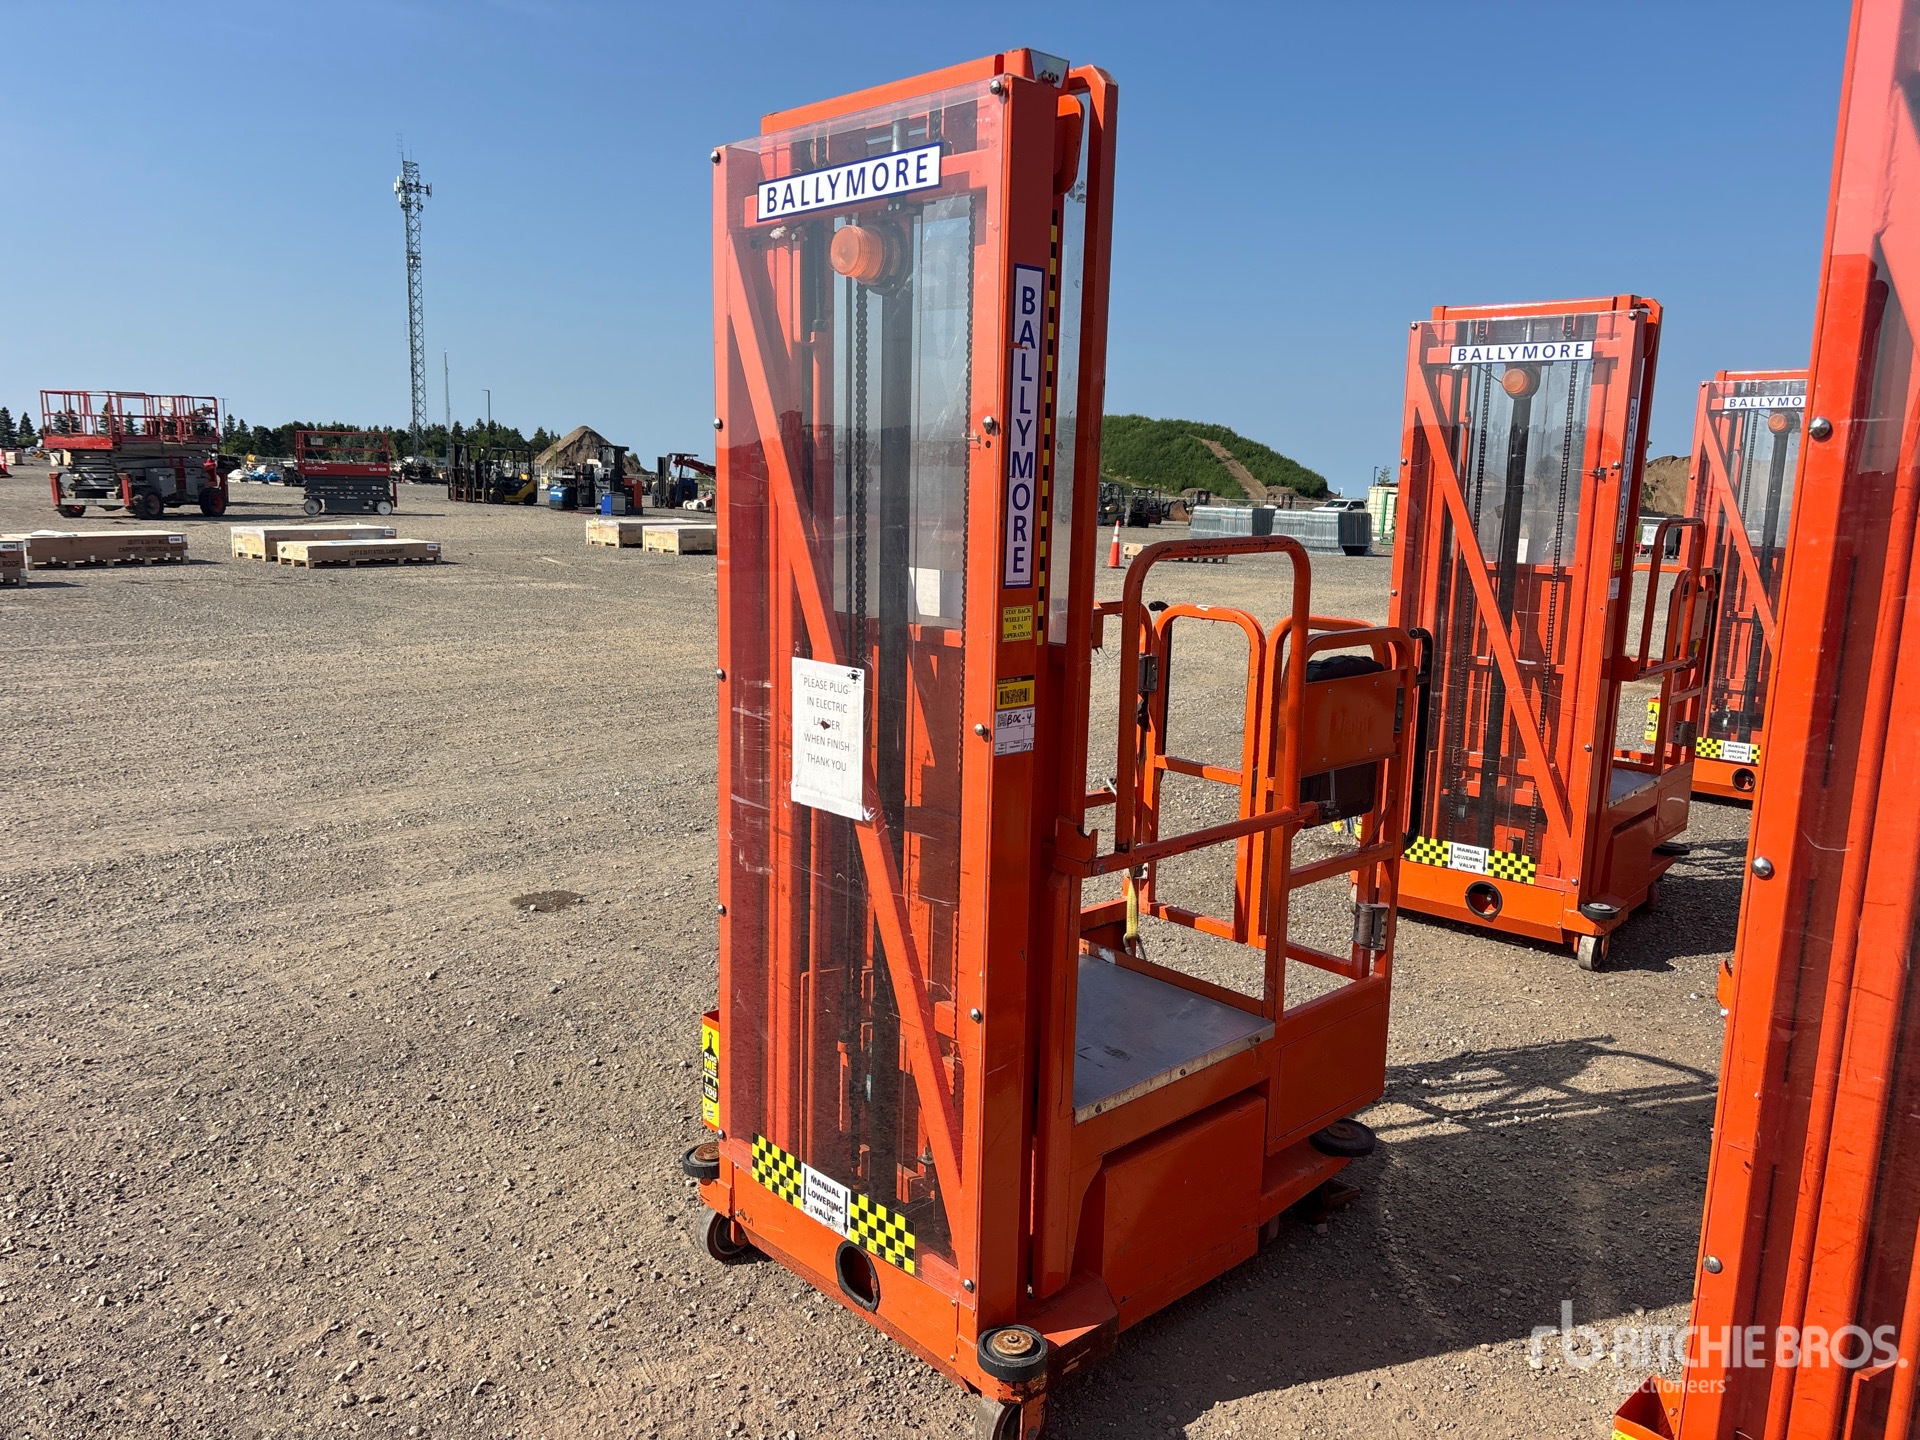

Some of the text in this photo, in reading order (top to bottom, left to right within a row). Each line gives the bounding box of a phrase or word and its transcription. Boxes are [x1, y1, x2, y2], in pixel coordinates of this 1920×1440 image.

[766, 152, 929, 213] BALLYMORE
[1457, 343, 1585, 361] BALLYMORE
[1011, 285, 1036, 573] BALLYMORE
[1004, 631, 1032, 639] OPERATION
[803, 676, 828, 691] PLEASE
[806, 696, 848, 714] IN ELECTRIC
[803, 731, 826, 746] WHEN
[806, 752, 847, 772] THANK YOU
[1453, 854, 1483, 864] LOWERING
[1456, 846, 1481, 856] MANUAL
[1458, 861, 1476, 870] VALVE
[703, 1084, 718, 1099] YOU
[810, 1174, 841, 1199] MANUAL
[807, 1186, 844, 1215] LOWERING
[813, 1205, 837, 1223] VALVE
